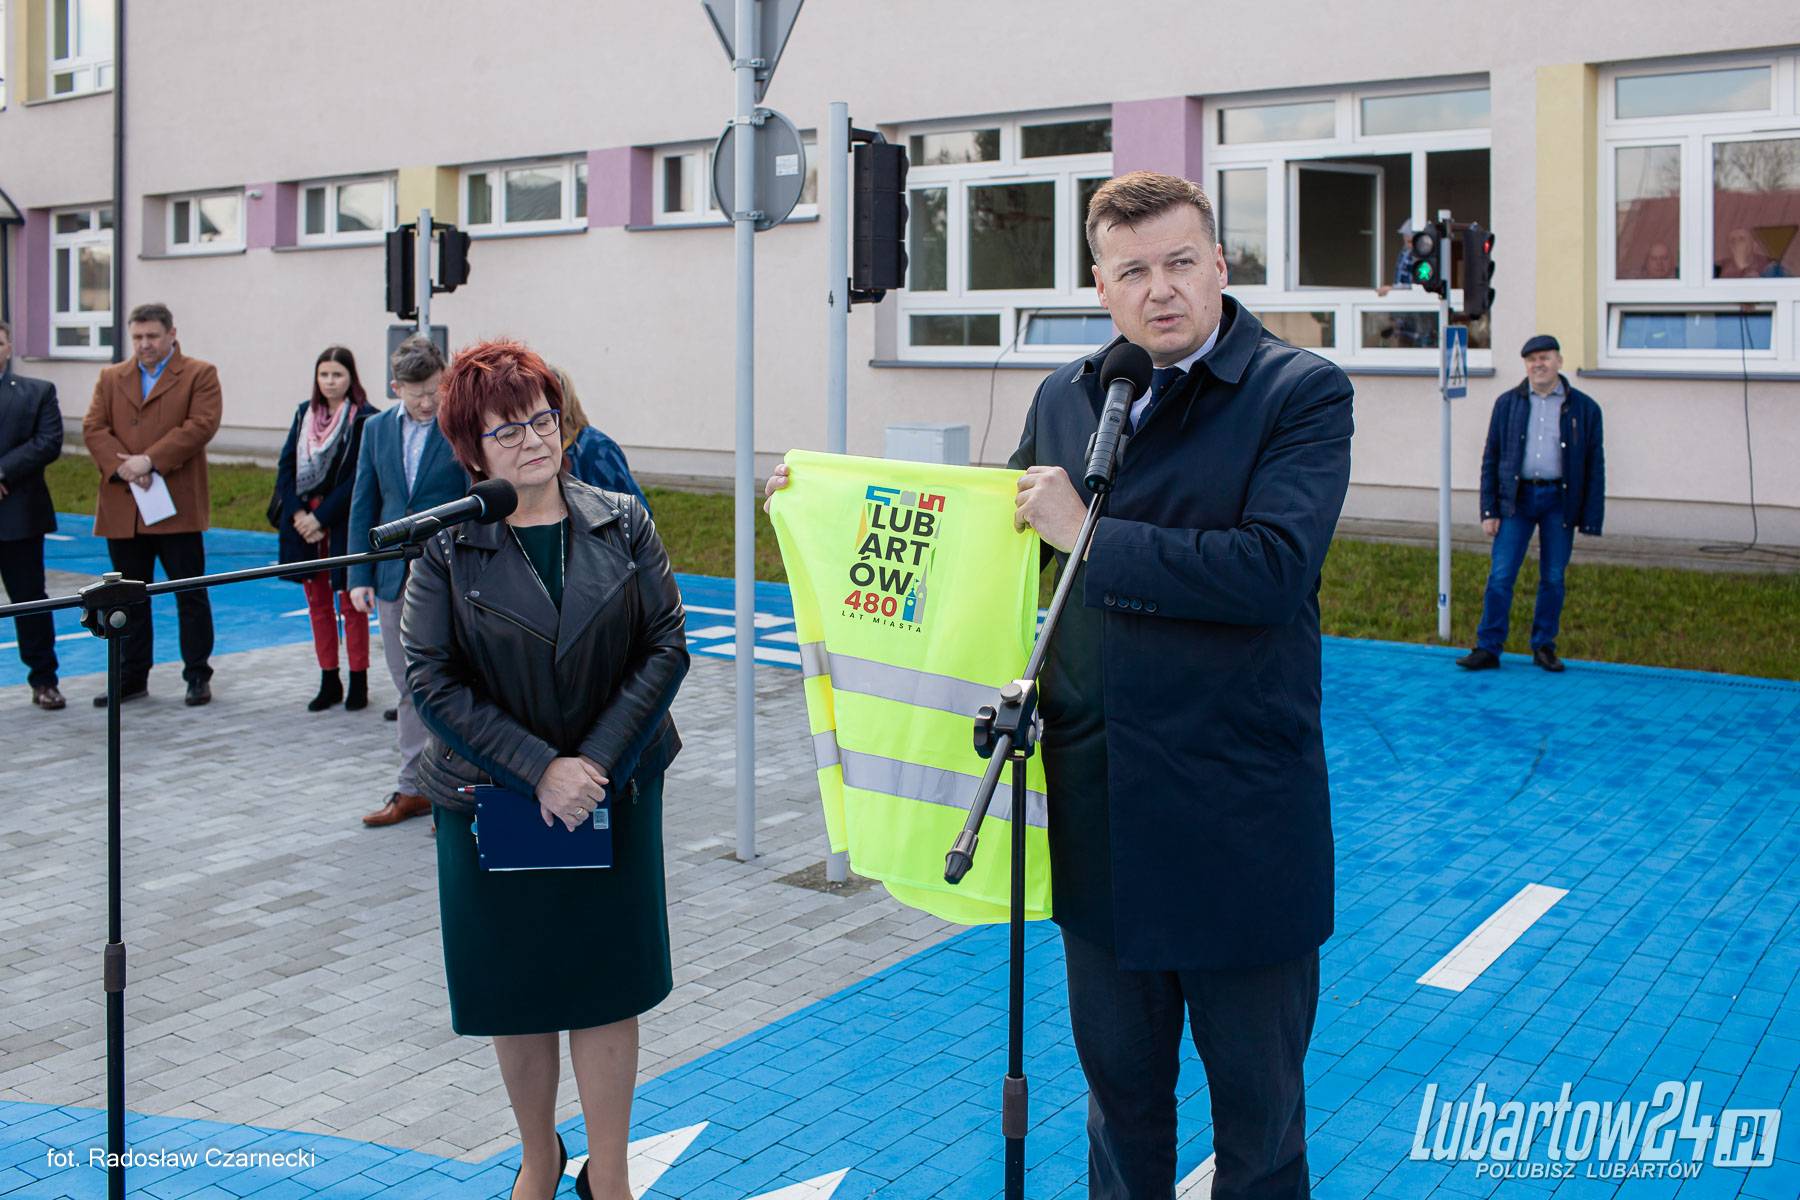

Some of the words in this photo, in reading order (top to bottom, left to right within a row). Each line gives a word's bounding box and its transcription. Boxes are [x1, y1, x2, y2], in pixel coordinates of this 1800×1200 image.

[871, 504, 935, 537] LUB
[858, 533, 929, 566] ART
[849, 554, 914, 595] ÓW
[844, 590, 898, 617] 480
[841, 611, 864, 620] LAT
[872, 617, 922, 633] MIASTA
